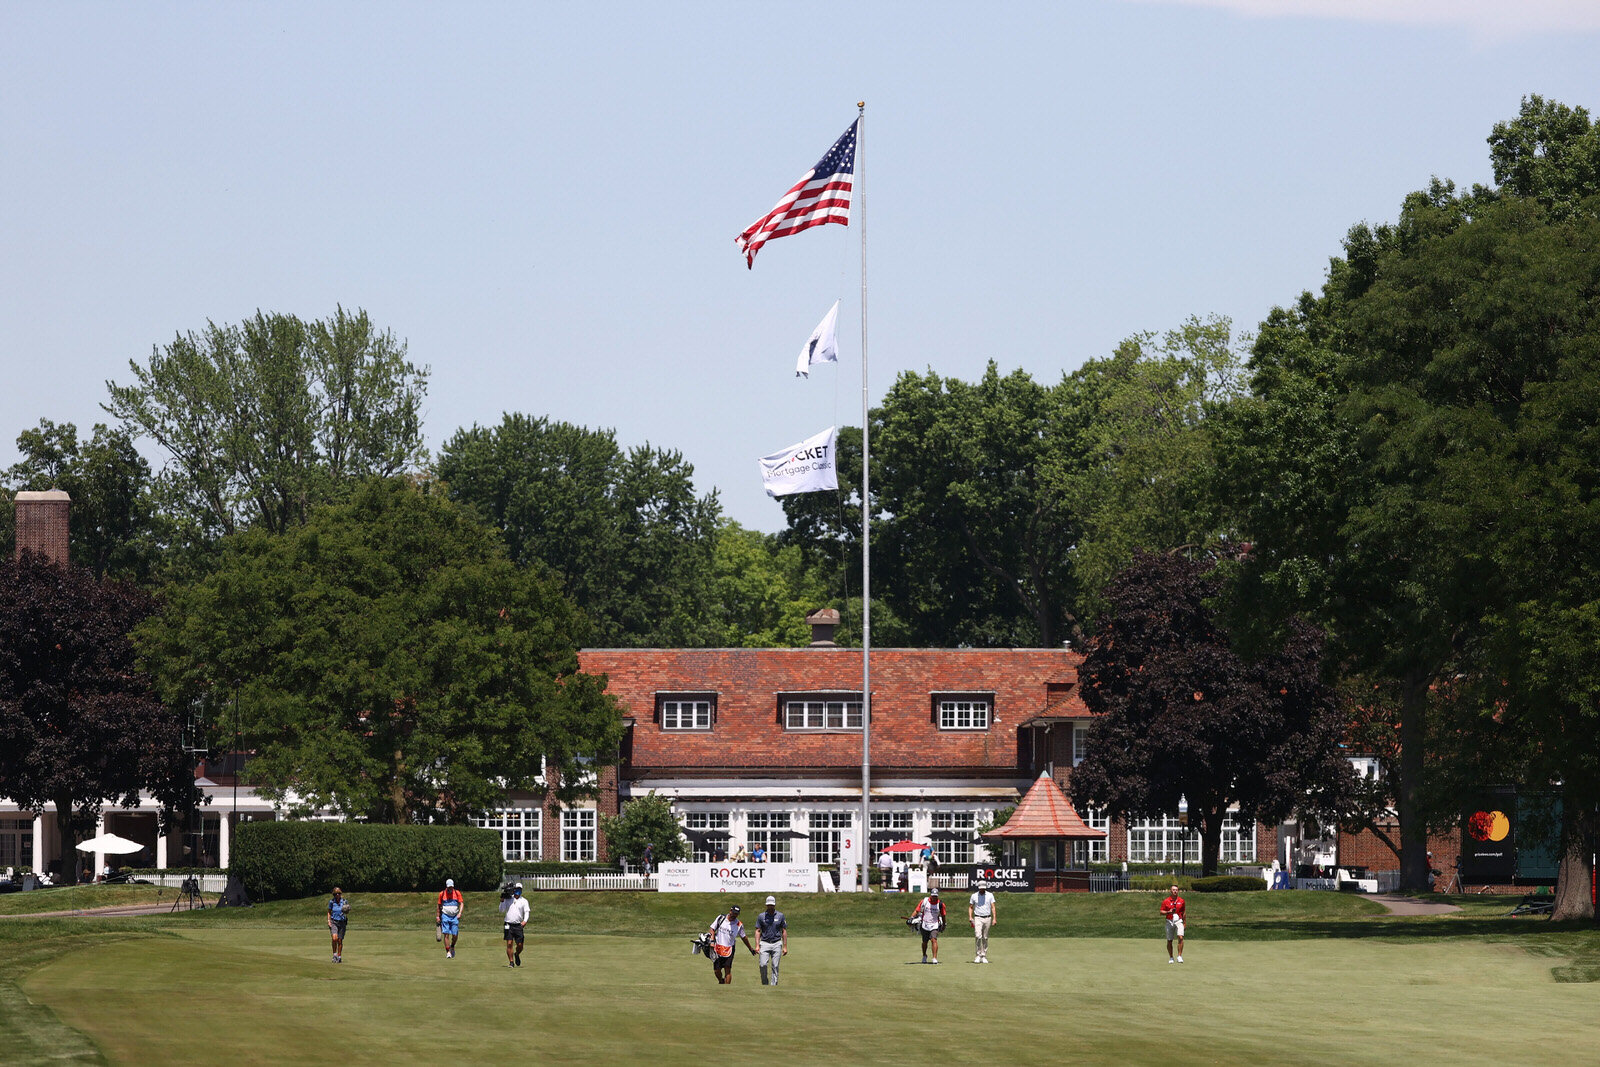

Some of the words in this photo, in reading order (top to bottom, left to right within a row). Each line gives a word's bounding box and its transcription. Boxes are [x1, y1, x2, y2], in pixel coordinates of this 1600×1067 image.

[845, 839, 852, 849] 3
[710, 868, 766, 878] ROCKET
[976, 868, 1026, 879] ROCKET
